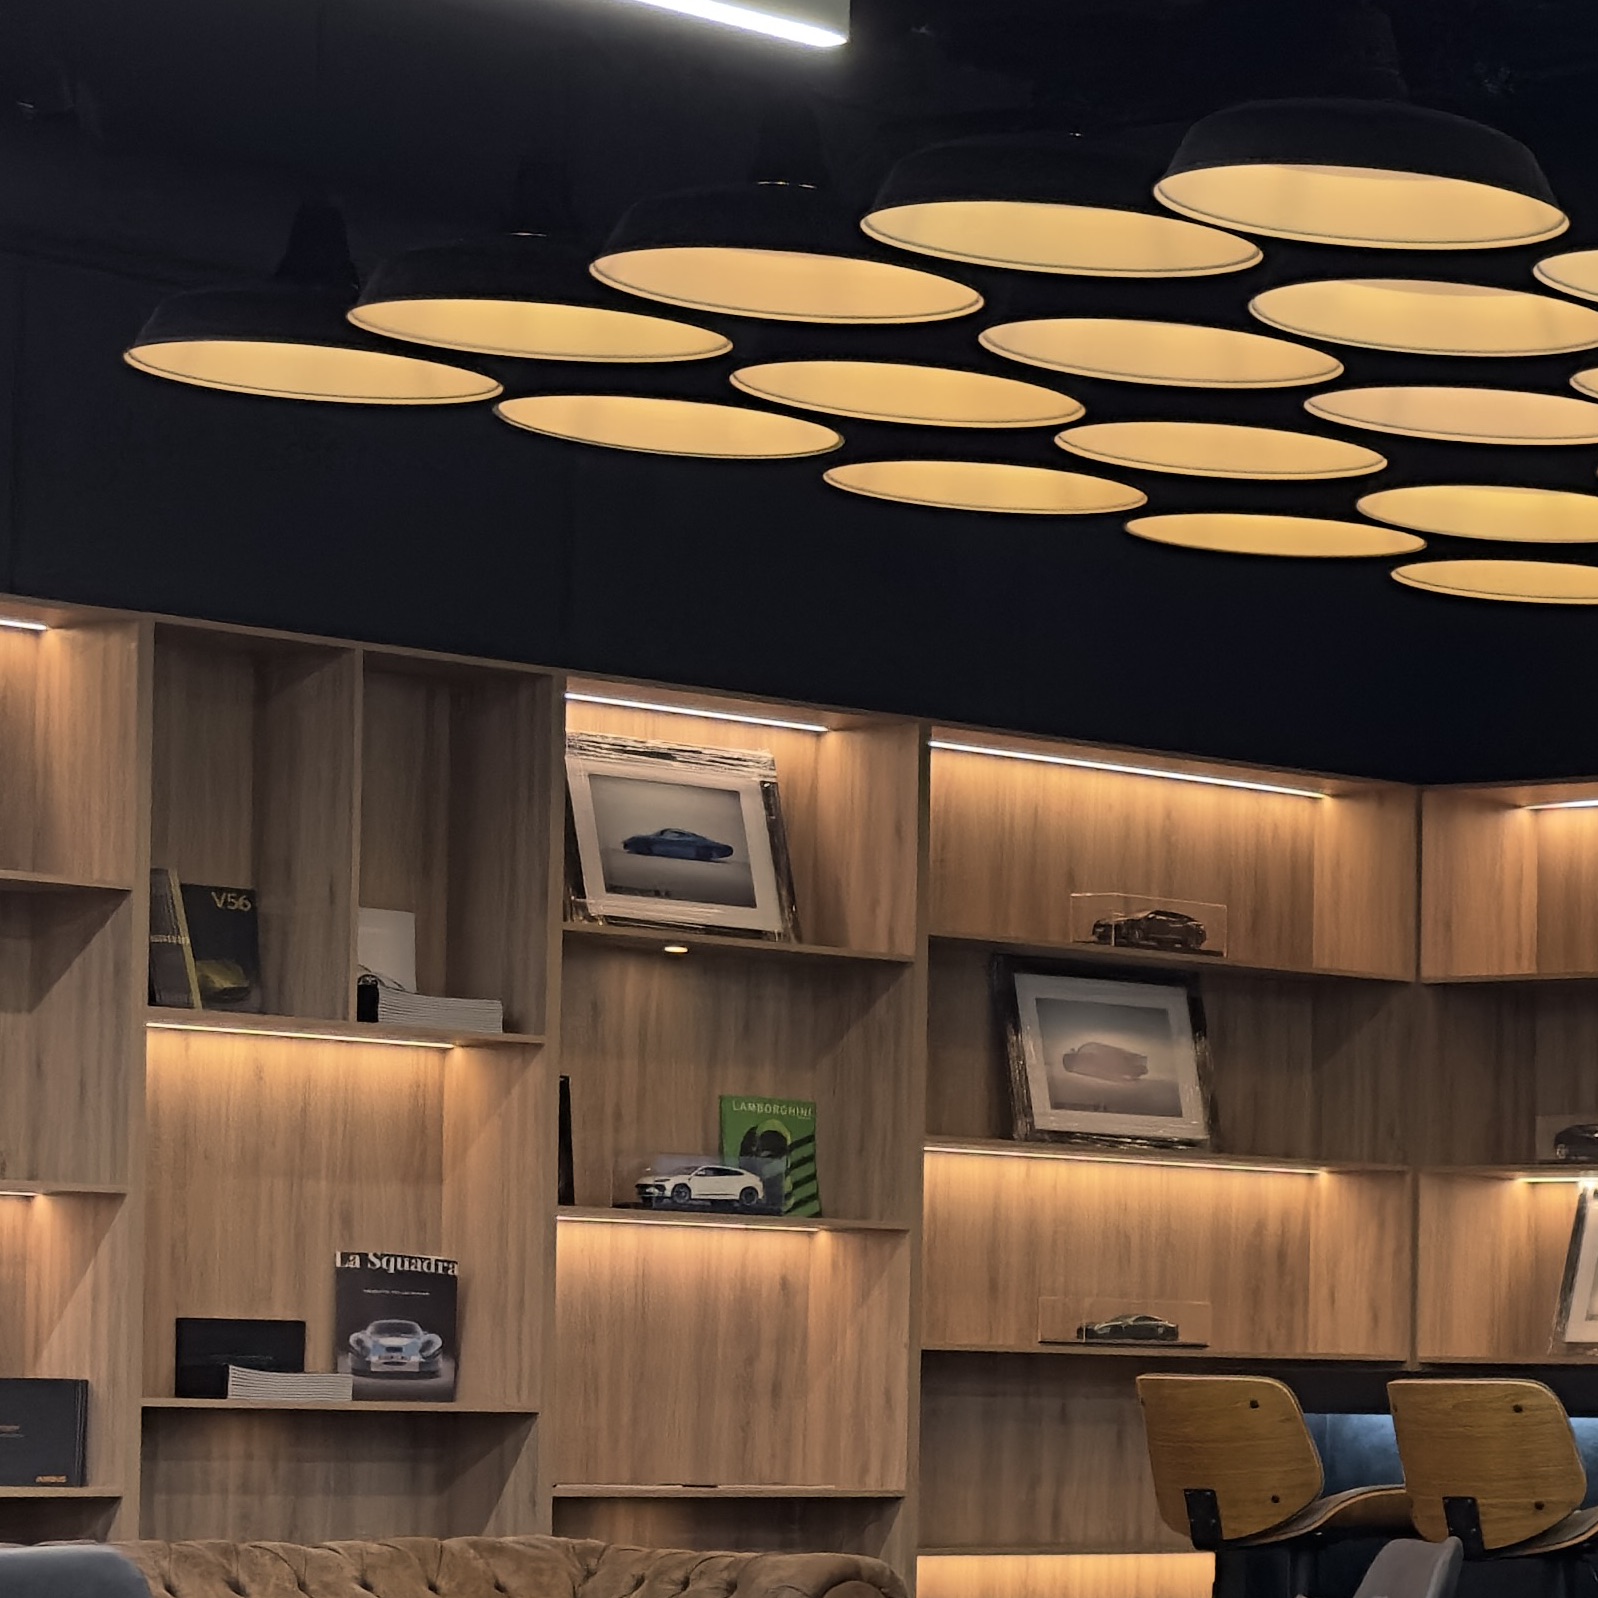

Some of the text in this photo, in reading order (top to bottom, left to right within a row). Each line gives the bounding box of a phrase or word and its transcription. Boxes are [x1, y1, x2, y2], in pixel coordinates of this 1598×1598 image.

[211, 892, 252, 912] V56
[336, 1251, 459, 1276] La Squadra
